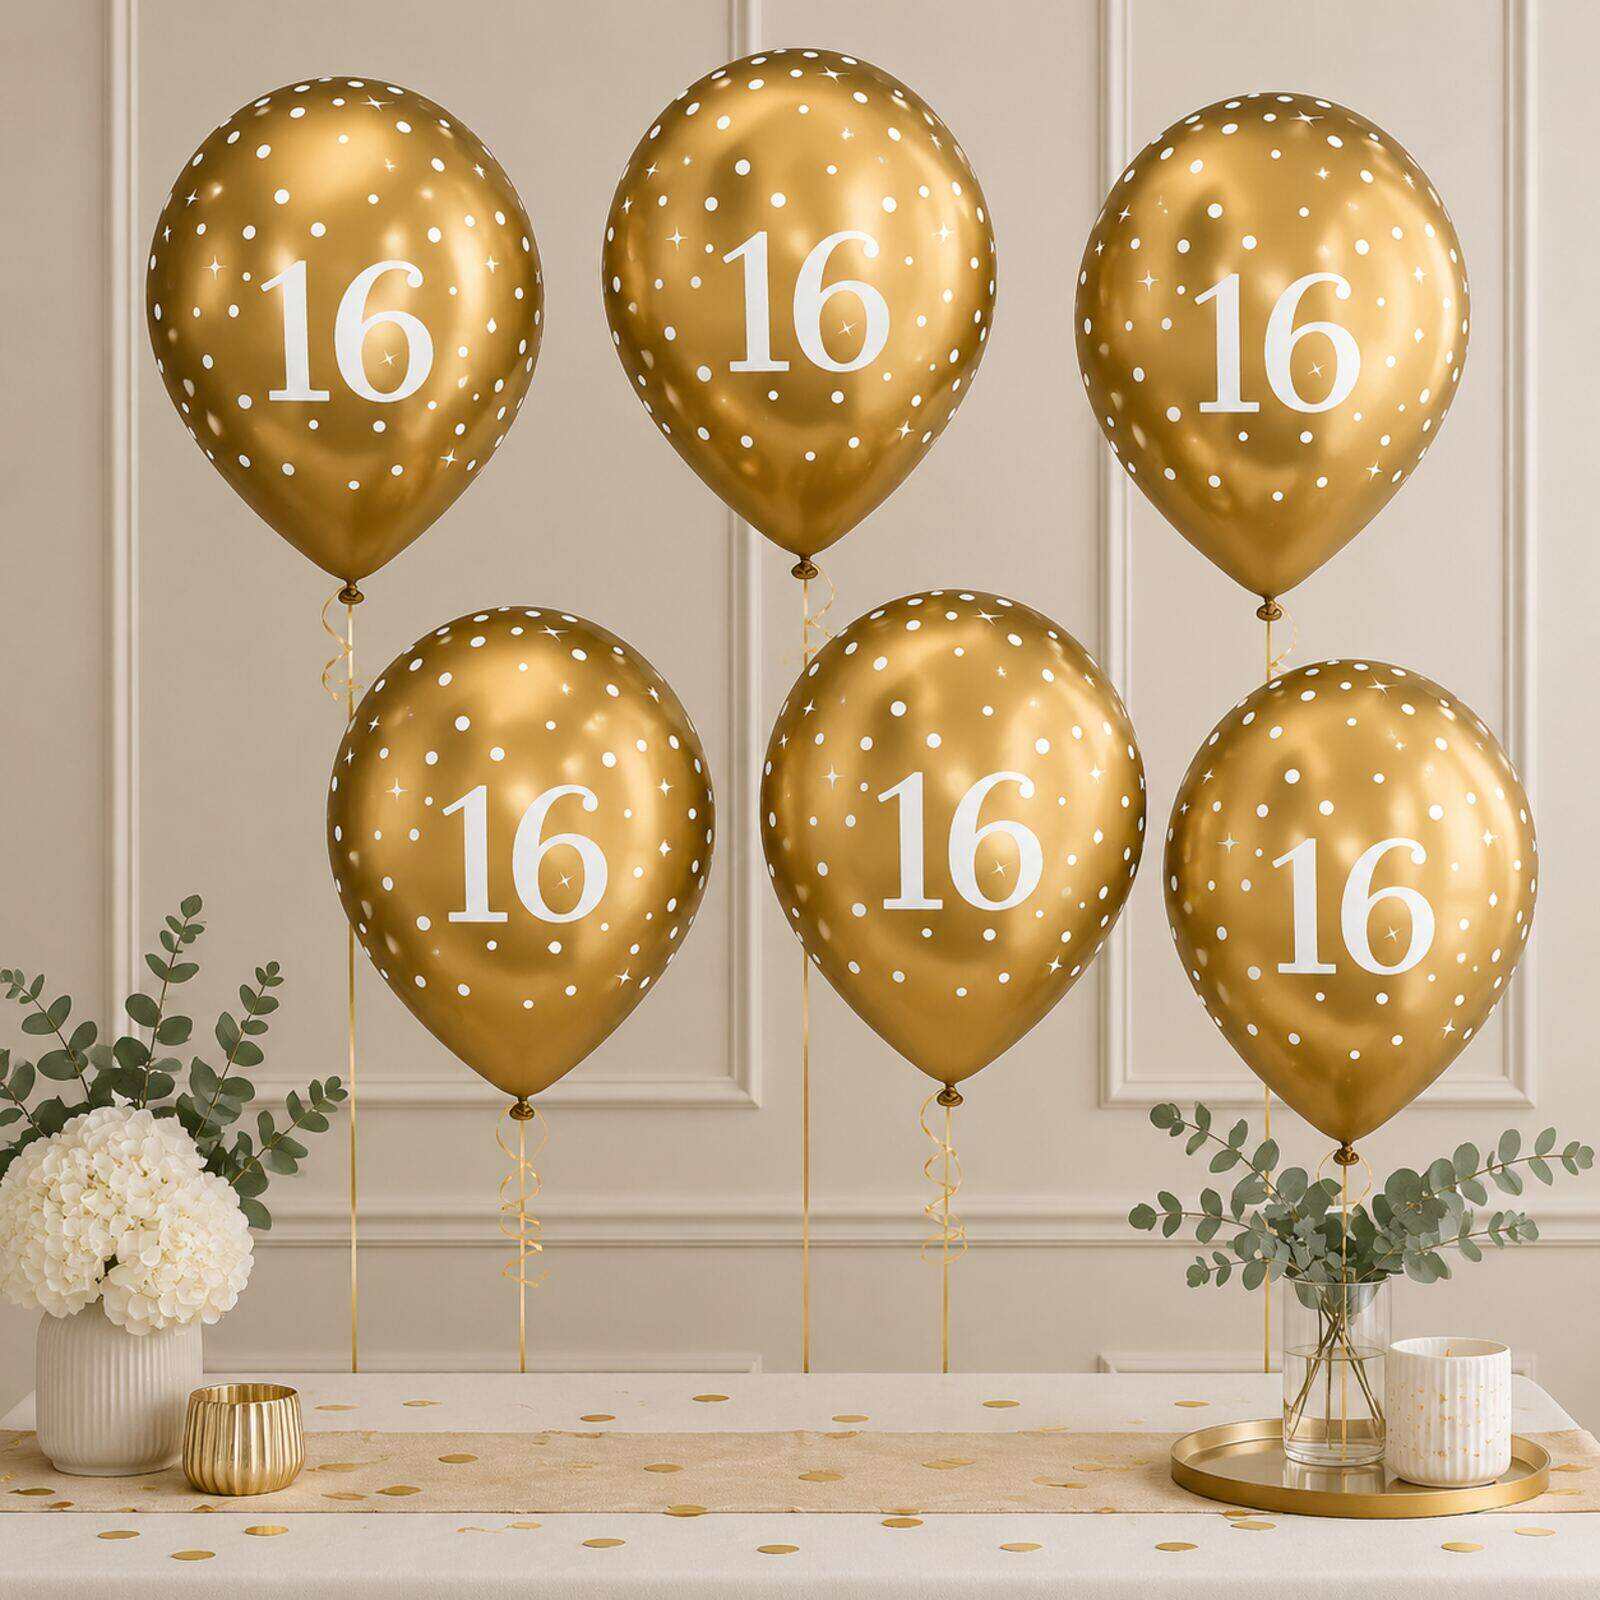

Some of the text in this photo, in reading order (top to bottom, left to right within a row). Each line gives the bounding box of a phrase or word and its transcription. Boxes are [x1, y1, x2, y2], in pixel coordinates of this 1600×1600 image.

[261, 260, 434, 403] 16
[723, 230, 890, 373] 16
[1195, 272, 1362, 413] 16
[442, 785, 608, 923] 16
[877, 771, 1043, 911] 16
[1272, 837, 1435, 975] 16
